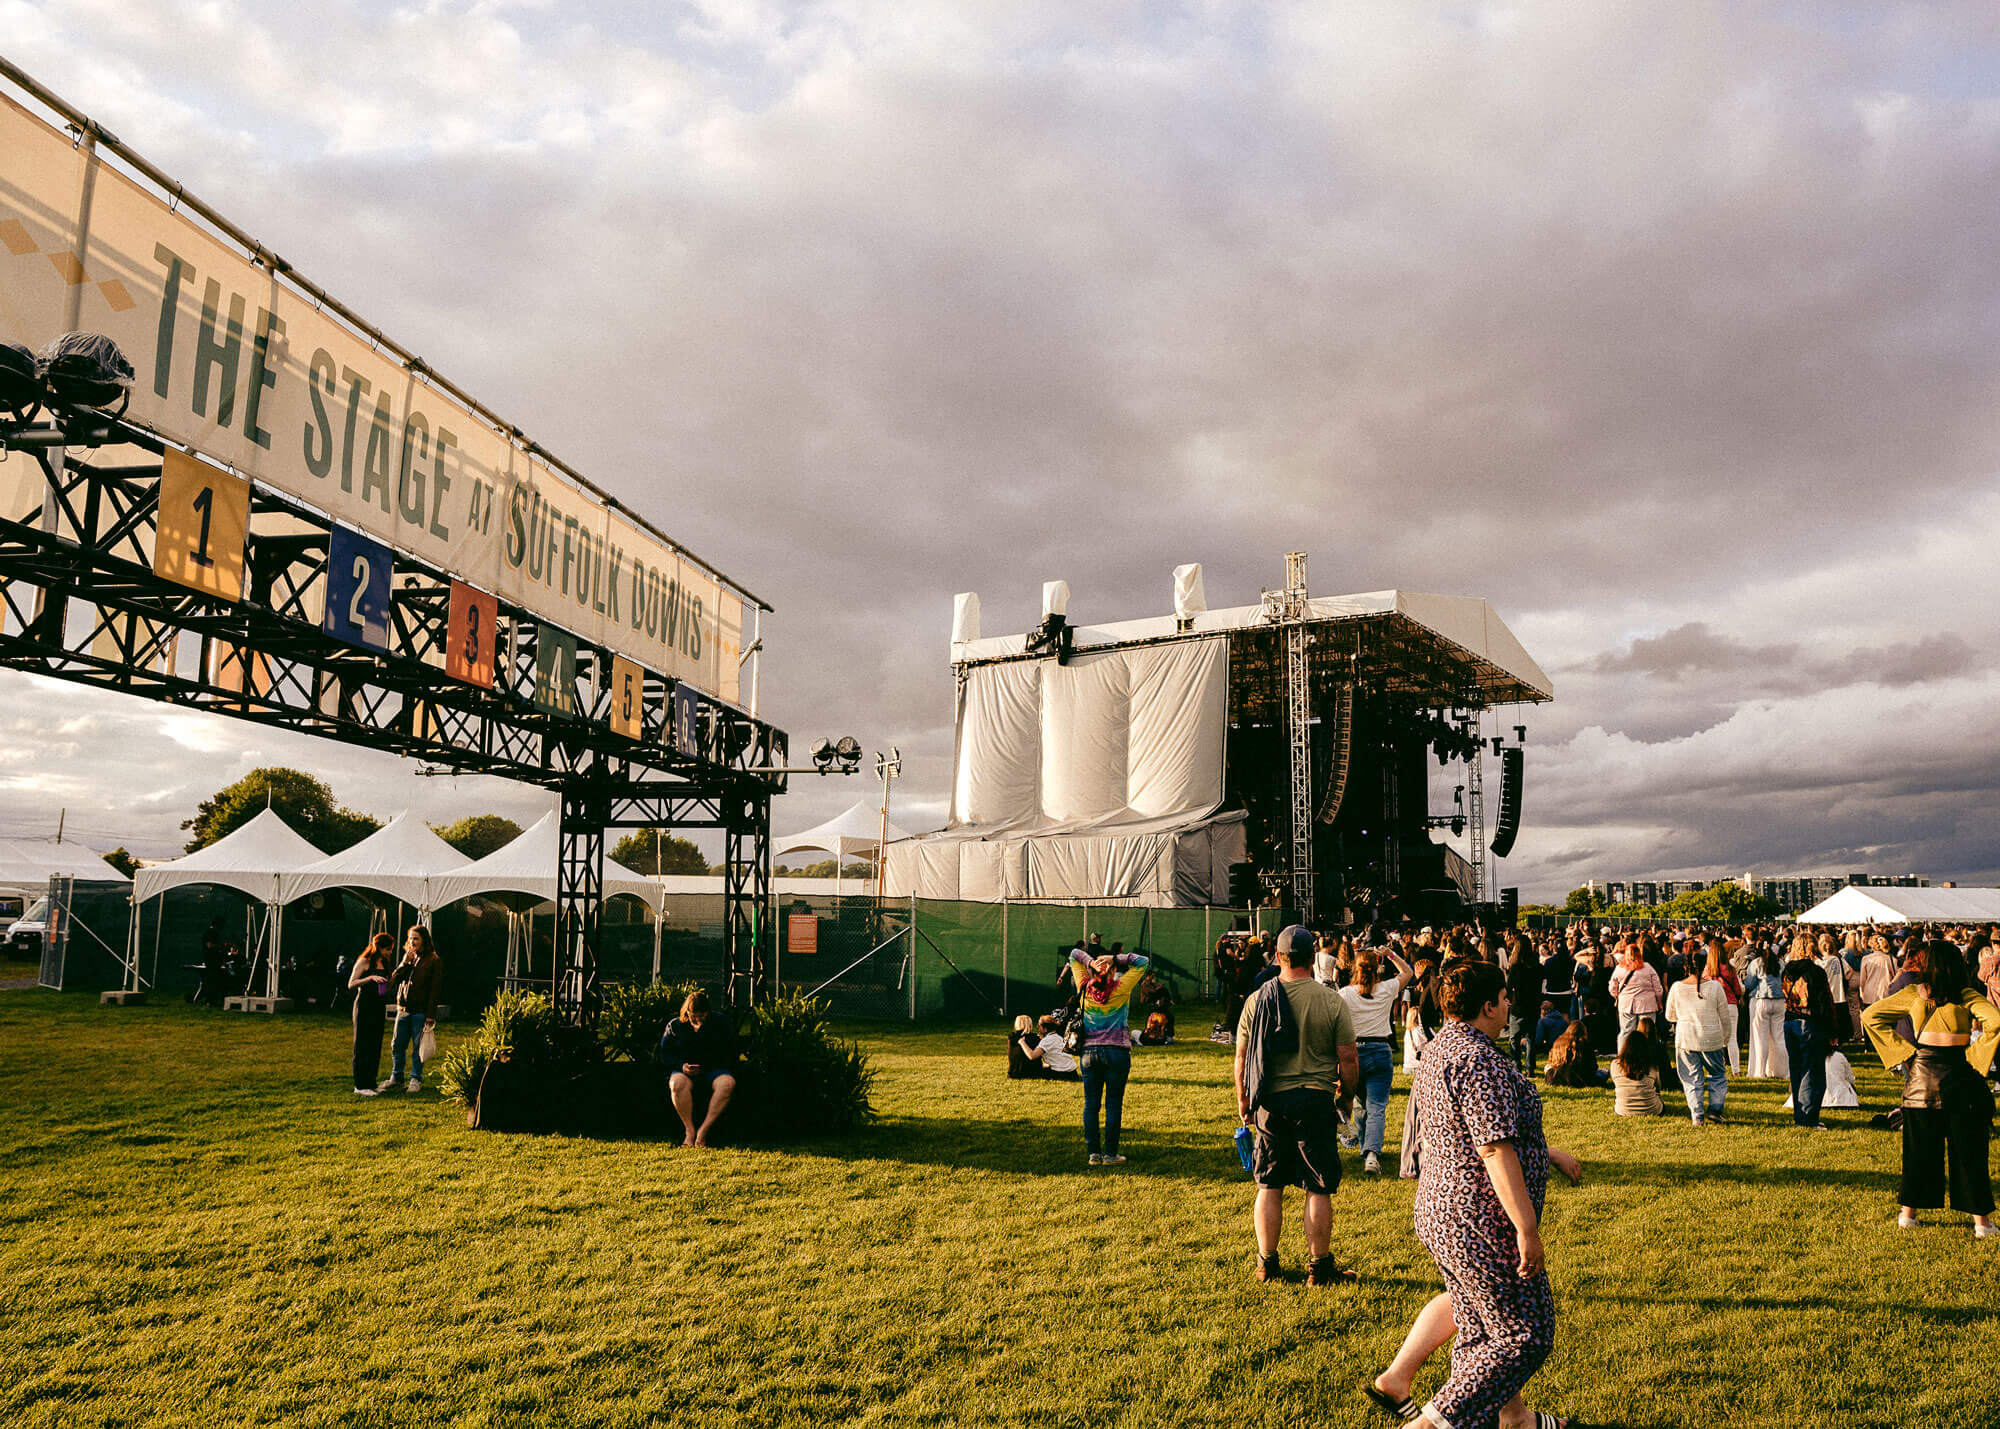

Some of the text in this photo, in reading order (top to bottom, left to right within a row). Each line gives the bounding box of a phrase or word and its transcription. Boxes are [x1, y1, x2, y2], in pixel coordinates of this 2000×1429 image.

[154, 241, 703, 662] THE STAGE AT SUFFOLK DOWNS
[190, 486, 214, 568] 1
[350, 554, 371, 629] 2
[464, 604, 480, 665] 3
[549, 643, 563, 702] 4
[623, 674, 633, 722] 5
[680, 698, 689, 743] 6
